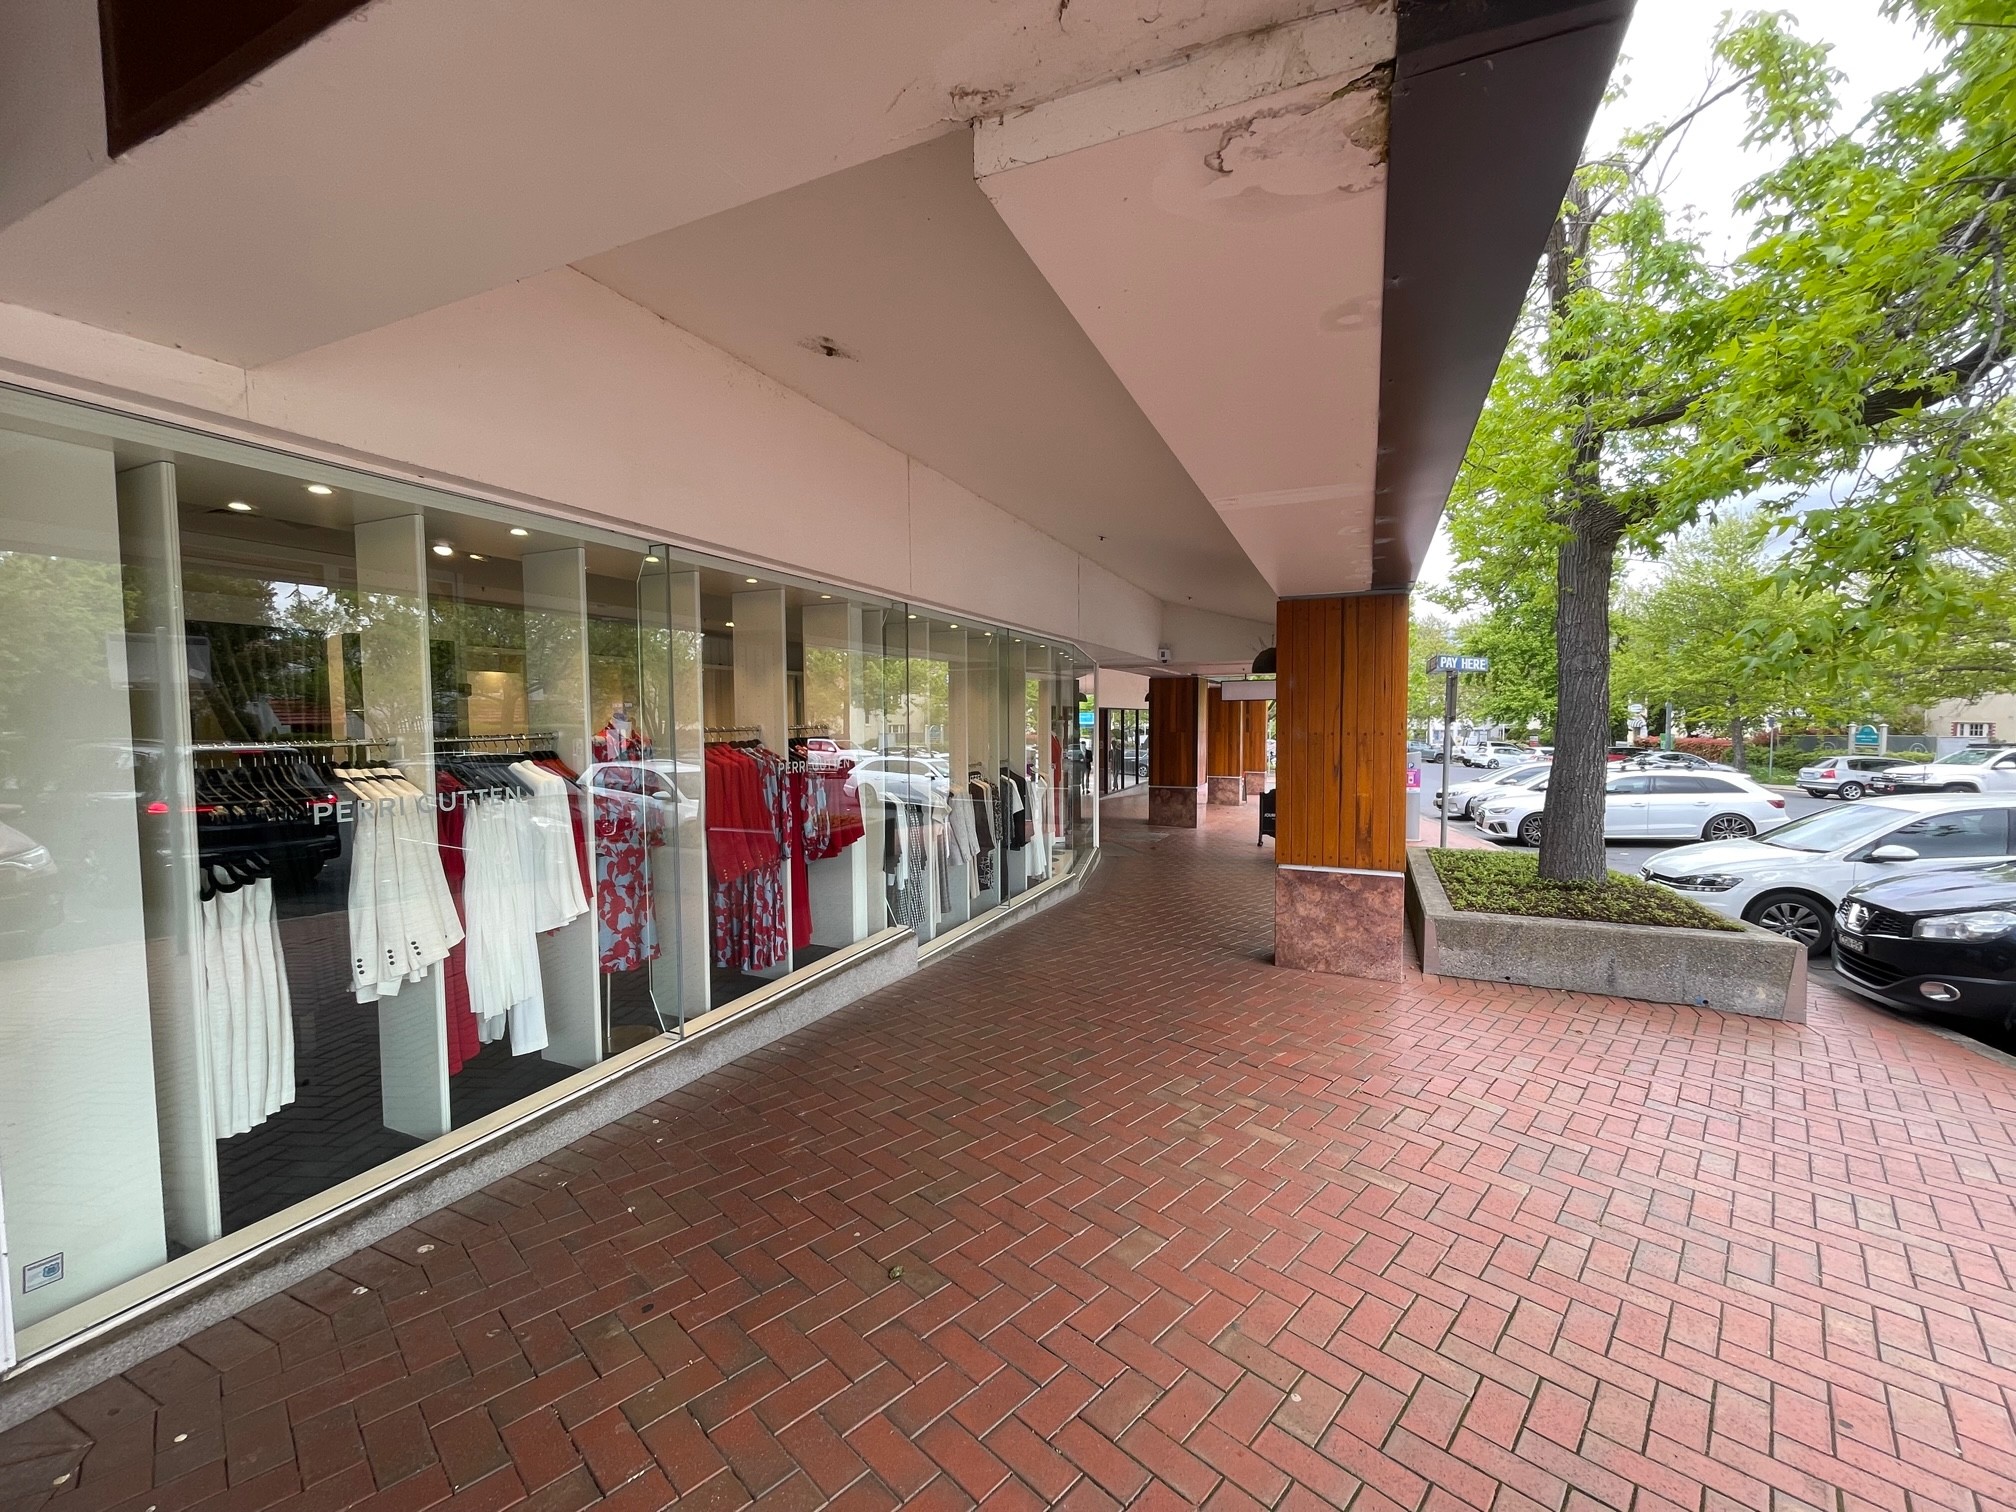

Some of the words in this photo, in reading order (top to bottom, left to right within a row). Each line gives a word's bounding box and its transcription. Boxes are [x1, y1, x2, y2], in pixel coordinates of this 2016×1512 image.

[1440, 656, 1457, 669] PAY
[1461, 657, 1486, 670] HERE
[778, 760, 809, 776] PERRI
[313, 796, 405, 825] PERRI
[418, 785, 521, 813] CUTTEN
